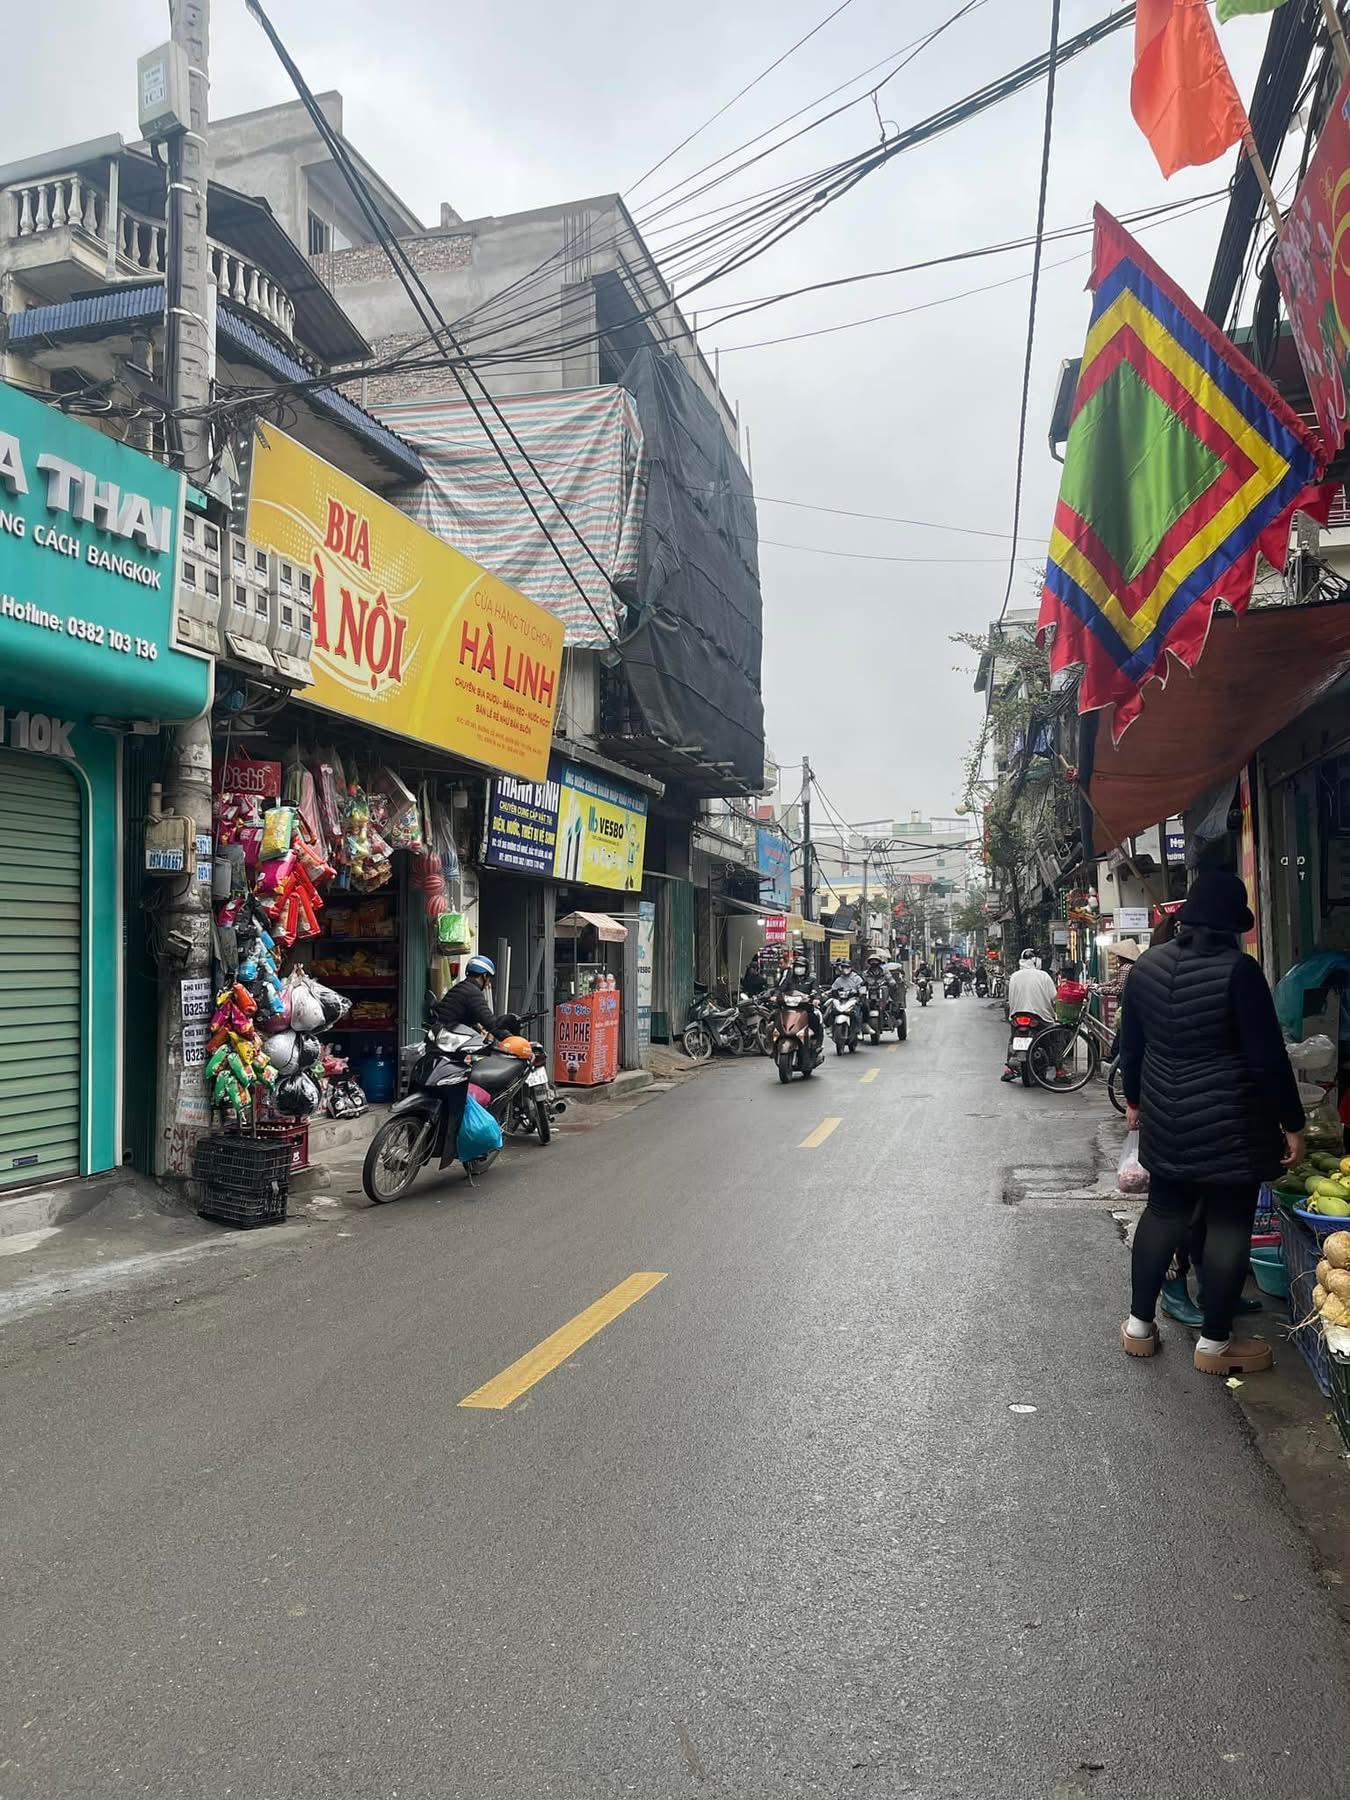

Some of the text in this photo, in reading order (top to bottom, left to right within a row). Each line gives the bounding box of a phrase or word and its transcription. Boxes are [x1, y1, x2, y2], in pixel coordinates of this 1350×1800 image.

[33, 523, 80, 559] CÁCH
[87, 545, 162, 590] BANGKOK
[323, 497, 372, 572] BIA
[2, 594, 158, 661] Hotline: 0382 103 136
[335, 591, 407, 690] NỘI
[458, 620, 556, 708] HÀ LINH
[10, 710, 76, 758] 10K
[219, 766, 265, 792] Oishi
[599, 817, 624, 839] VESBO
[184, 982, 195, 992] CHO
[195, 982, 203, 991] VAY
[560, 1051, 587, 1062] 15K
